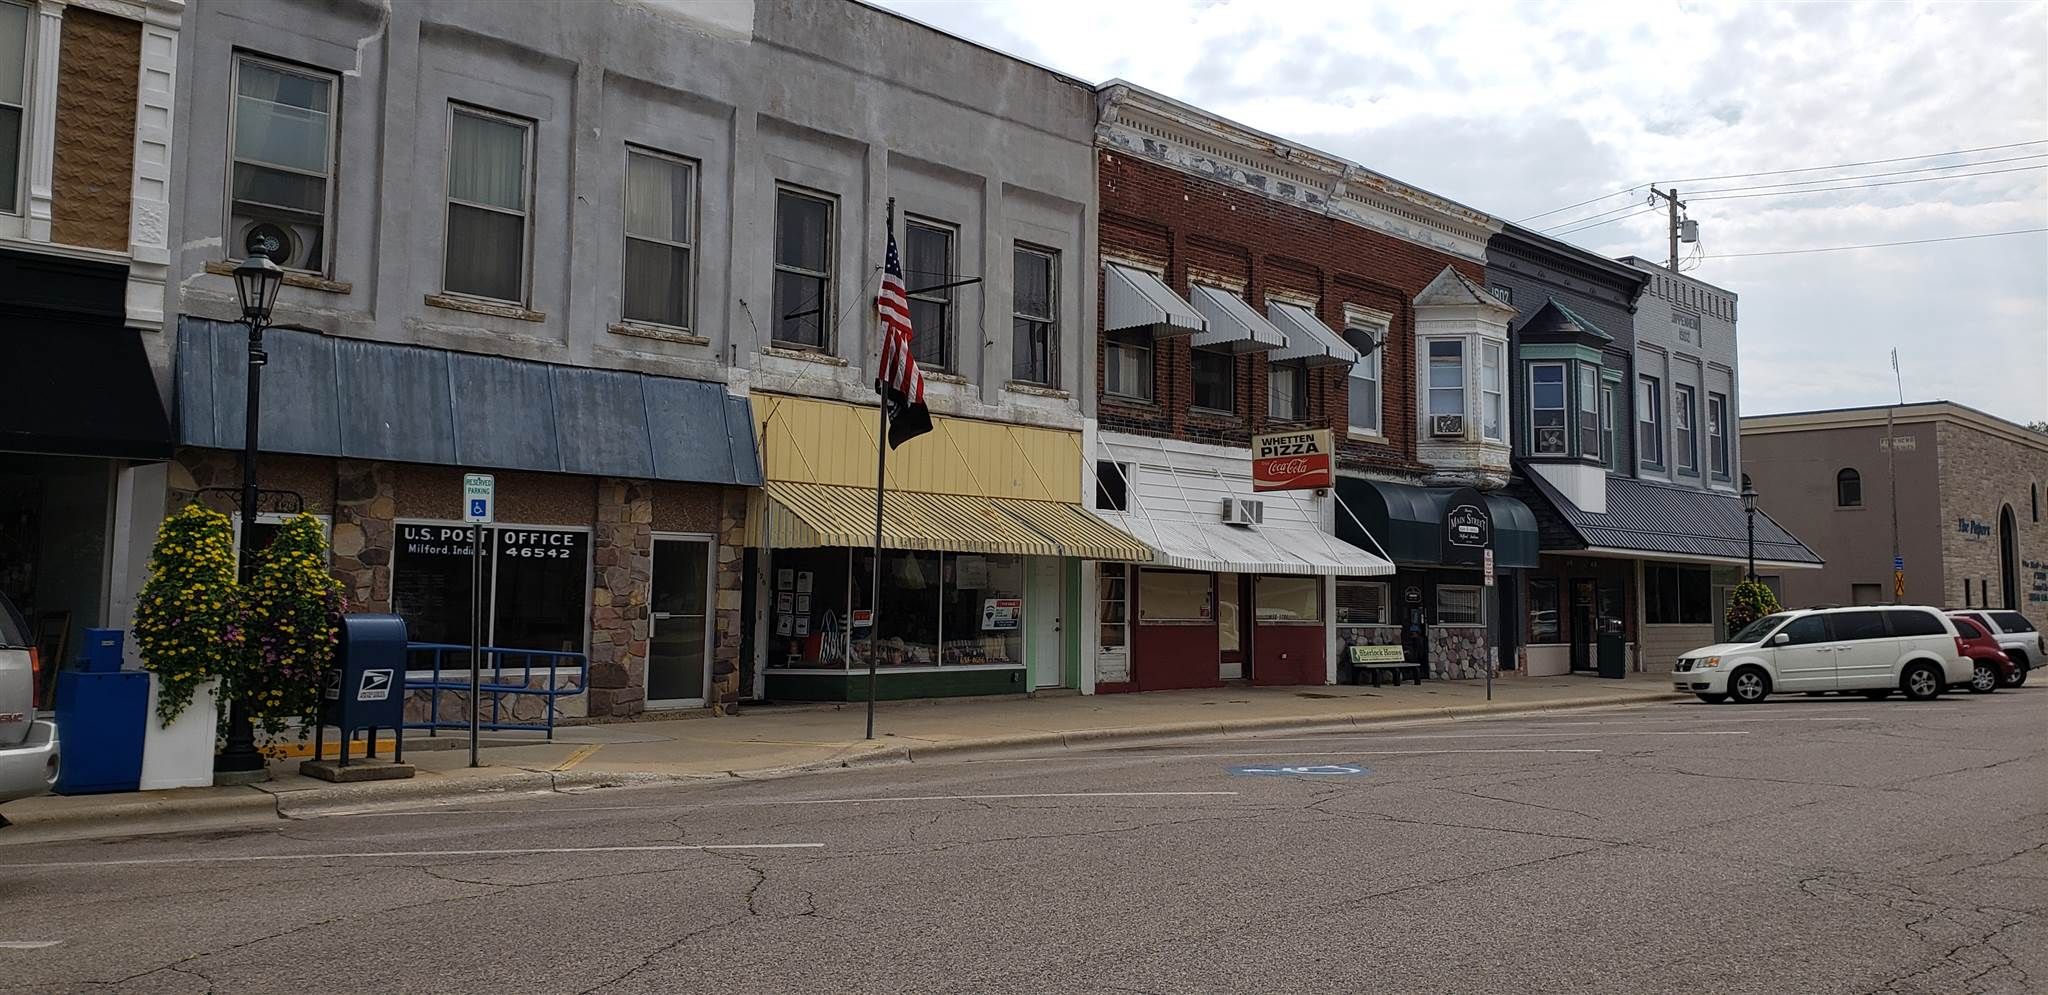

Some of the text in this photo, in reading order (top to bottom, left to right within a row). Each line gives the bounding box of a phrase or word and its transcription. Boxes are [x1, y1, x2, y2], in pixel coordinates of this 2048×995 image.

[1261, 434, 1315, 446] WHETTEN
[1260, 443, 1320, 457] PIZZA
[465, 478, 492, 487] RESERVED
[467, 487, 491, 495] PARKING
[404, 527, 575, 546] U.S. POST OFFICE
[505, 547, 570, 558] 46542
